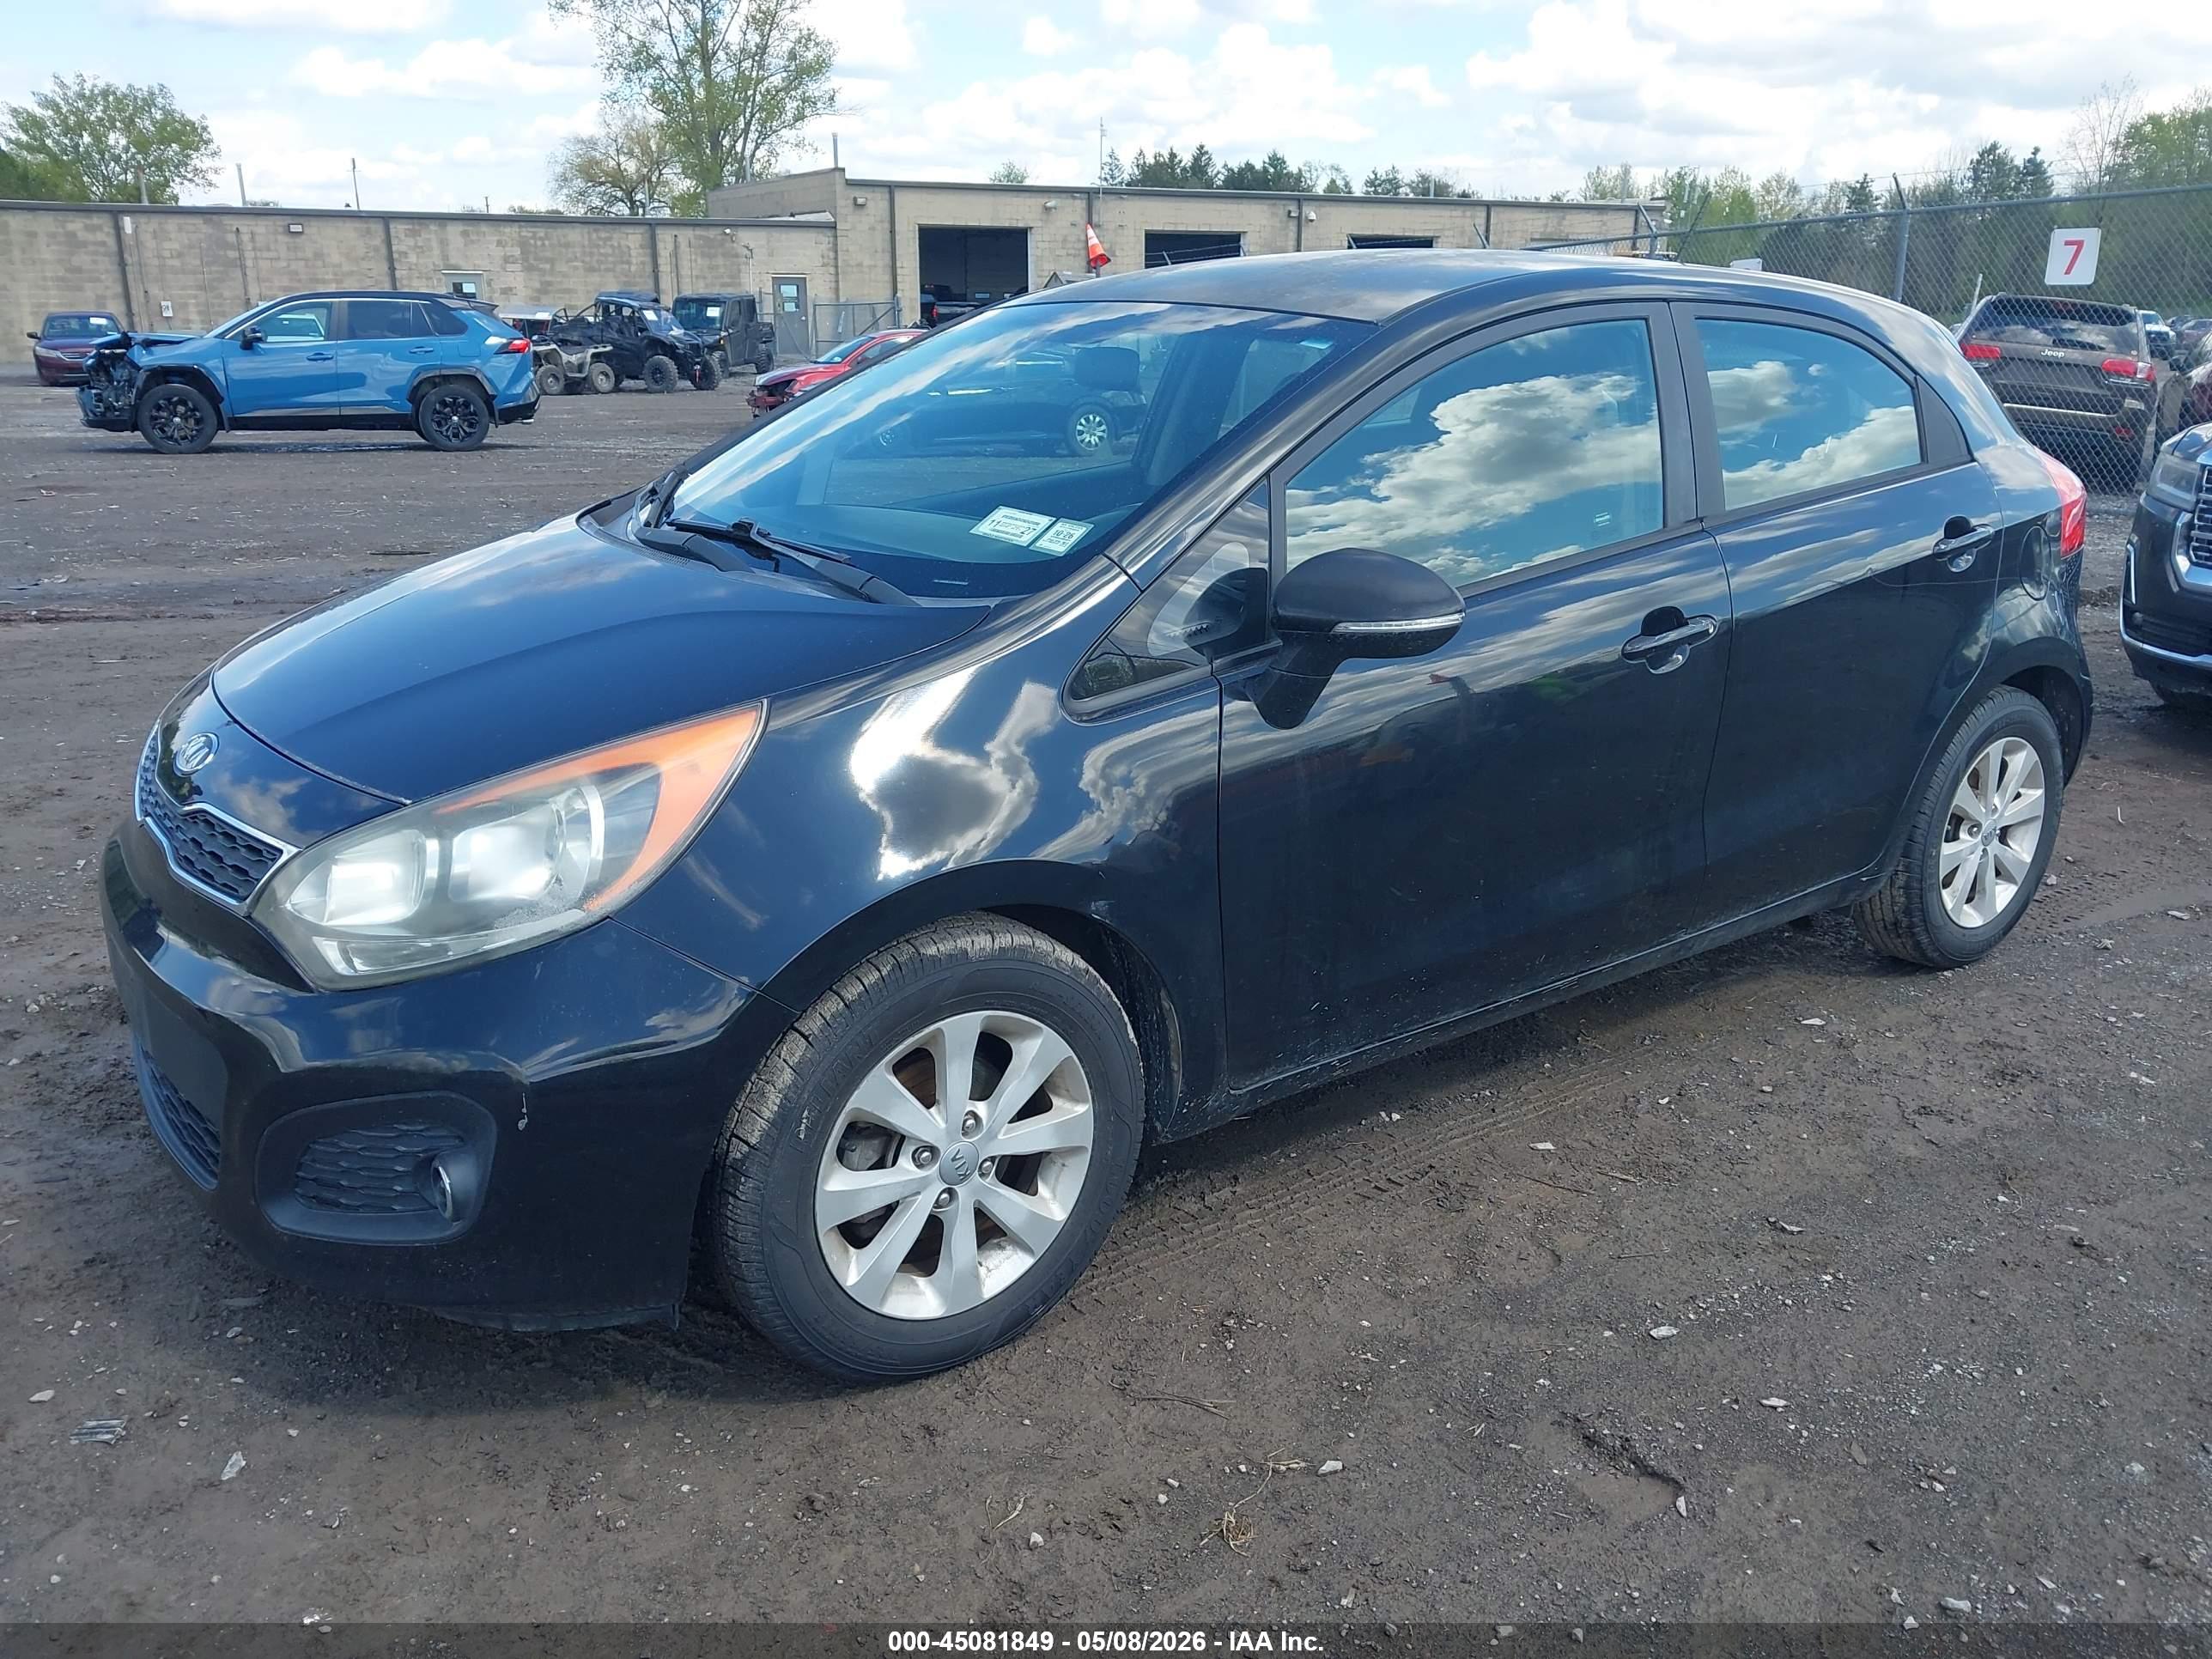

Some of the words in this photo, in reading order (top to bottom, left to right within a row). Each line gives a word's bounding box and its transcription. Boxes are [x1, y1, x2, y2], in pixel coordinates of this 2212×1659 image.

[2063, 239, 2086, 276] 7
[2040, 349, 2065, 359] Jeep
[1019, 526, 1037, 536] 27
[950, 1147, 971, 1182] KIA
